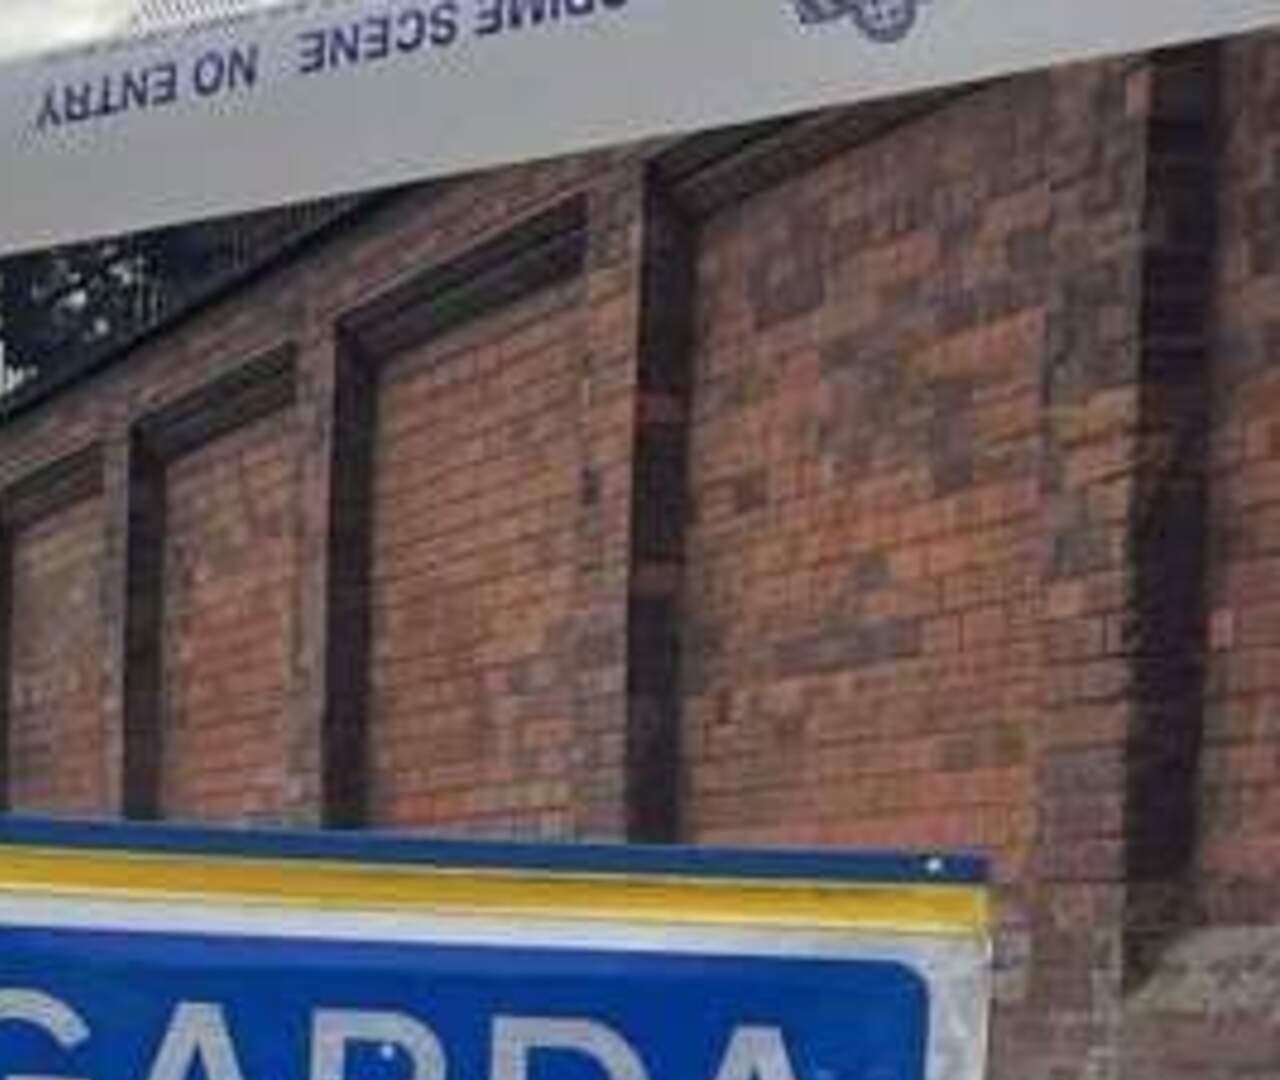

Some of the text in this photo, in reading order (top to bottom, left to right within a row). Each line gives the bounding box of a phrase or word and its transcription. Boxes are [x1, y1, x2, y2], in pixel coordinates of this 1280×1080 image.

[192, 44, 259, 97] NO
[297, 9, 458, 73] SCENE
[34, 62, 178, 129] ENTRY
